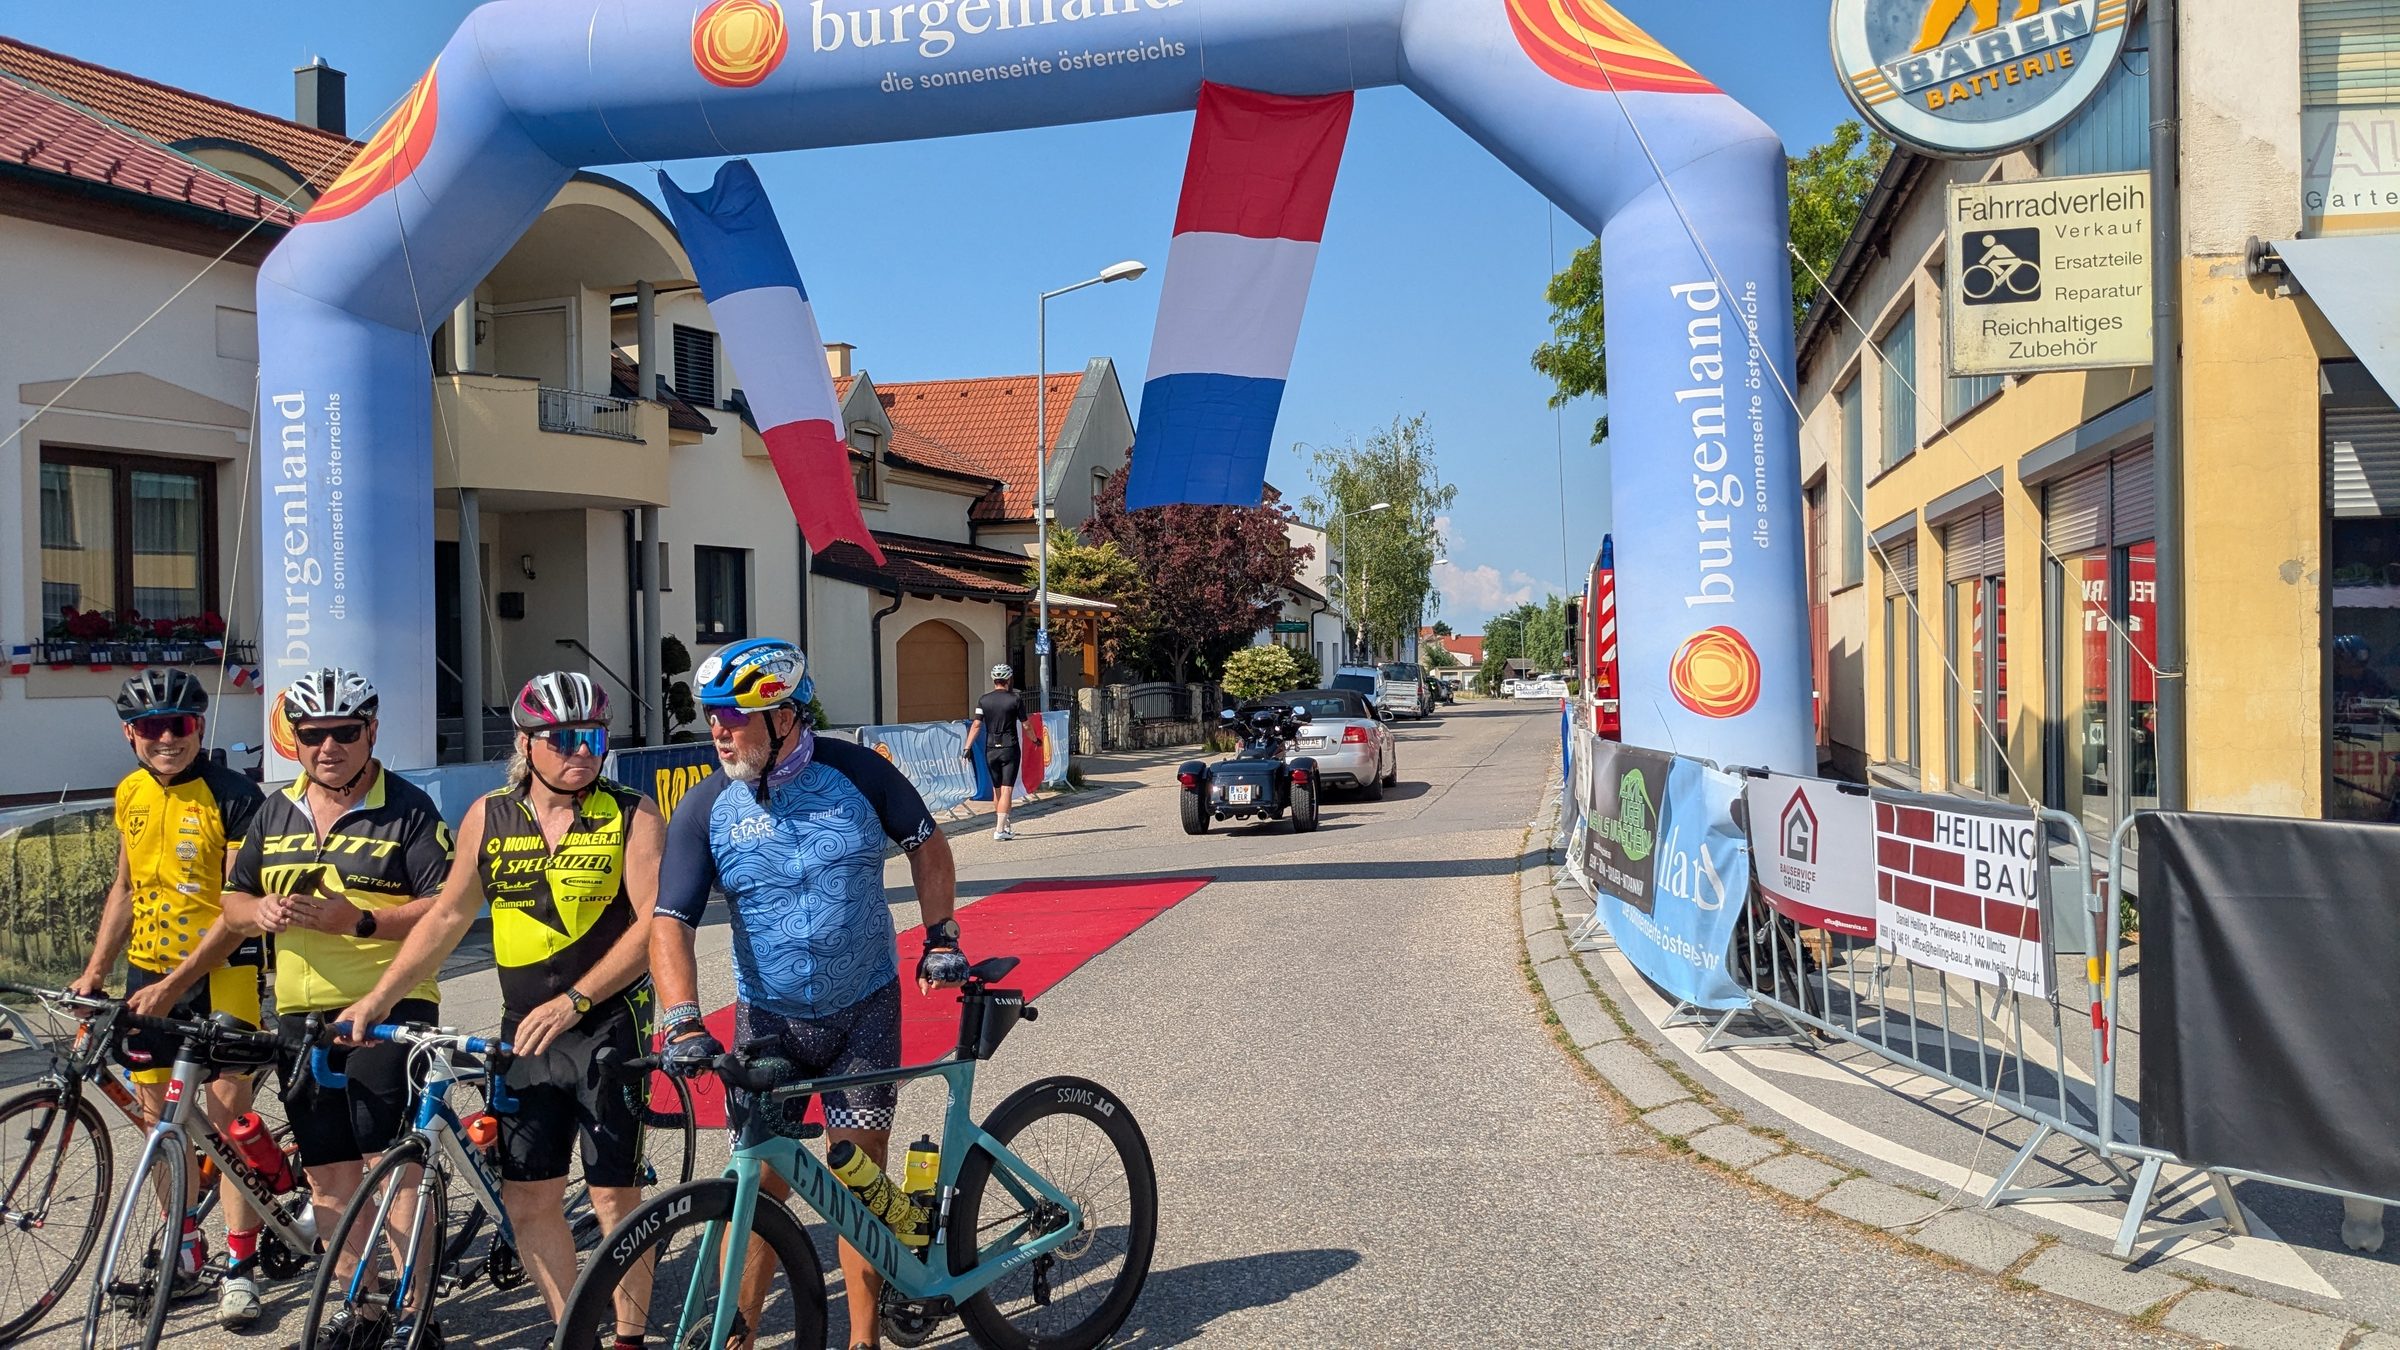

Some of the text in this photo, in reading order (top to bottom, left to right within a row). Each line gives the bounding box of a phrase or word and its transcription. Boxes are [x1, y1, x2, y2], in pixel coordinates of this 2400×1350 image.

[812, 0, 1184, 58] burgena
[1899, 3, 2088, 89] BÄREN
[880, 37, 1186, 94] die sonnenseite österreichs
[1925, 47, 2075, 110] BATTERIE
[1957, 185, 2145, 222] Fahrradverleih
[2305, 190, 2399, 211] Garte
[2055, 219, 2142, 239] Verkauf
[2055, 251, 2143, 270] Ersatzteile
[2055, 284, 2143, 303] Reparatur
[1982, 314, 2123, 337] Reichhaltiges
[2008, 338, 2098, 360] Zubehör
[1741, 281, 1769, 549] die sonnenseite österreichs
[1669, 277, 1745, 609] burgenland
[324, 392, 345, 620] die sonnenseite österreichs
[272, 390, 322, 669] burgenland
[750, 650, 785, 666] GIRO
[263, 832, 401, 858] SCOTT
[1936, 813, 2037, 861] HEILING
[1780, 863, 1817, 881] BAUSERVICE
[1783, 875, 1811, 893] GRUBER
[1975, 858, 2038, 901] BAU
[494, 899, 536, 909] SHIMANO
[1895, 911, 1910, 928] Daniel
[1929, 921, 1961, 942] Pfarrwiese
[1962, 930, 1968, 946] 9,
[1970, 932, 1985, 949] 7142
[1974, 956, 2040, 984] www.heilingbau.at
[1057, 1088, 1094, 1106] SWISS
[1093, 1097, 1115, 1117] DT
[204, 1132, 293, 1227] ARGON 18
[793, 1148, 899, 1280] CANYON
[612, 1195, 692, 1266] DT SWISS
[1001, 1247, 1038, 1269] CANYON
